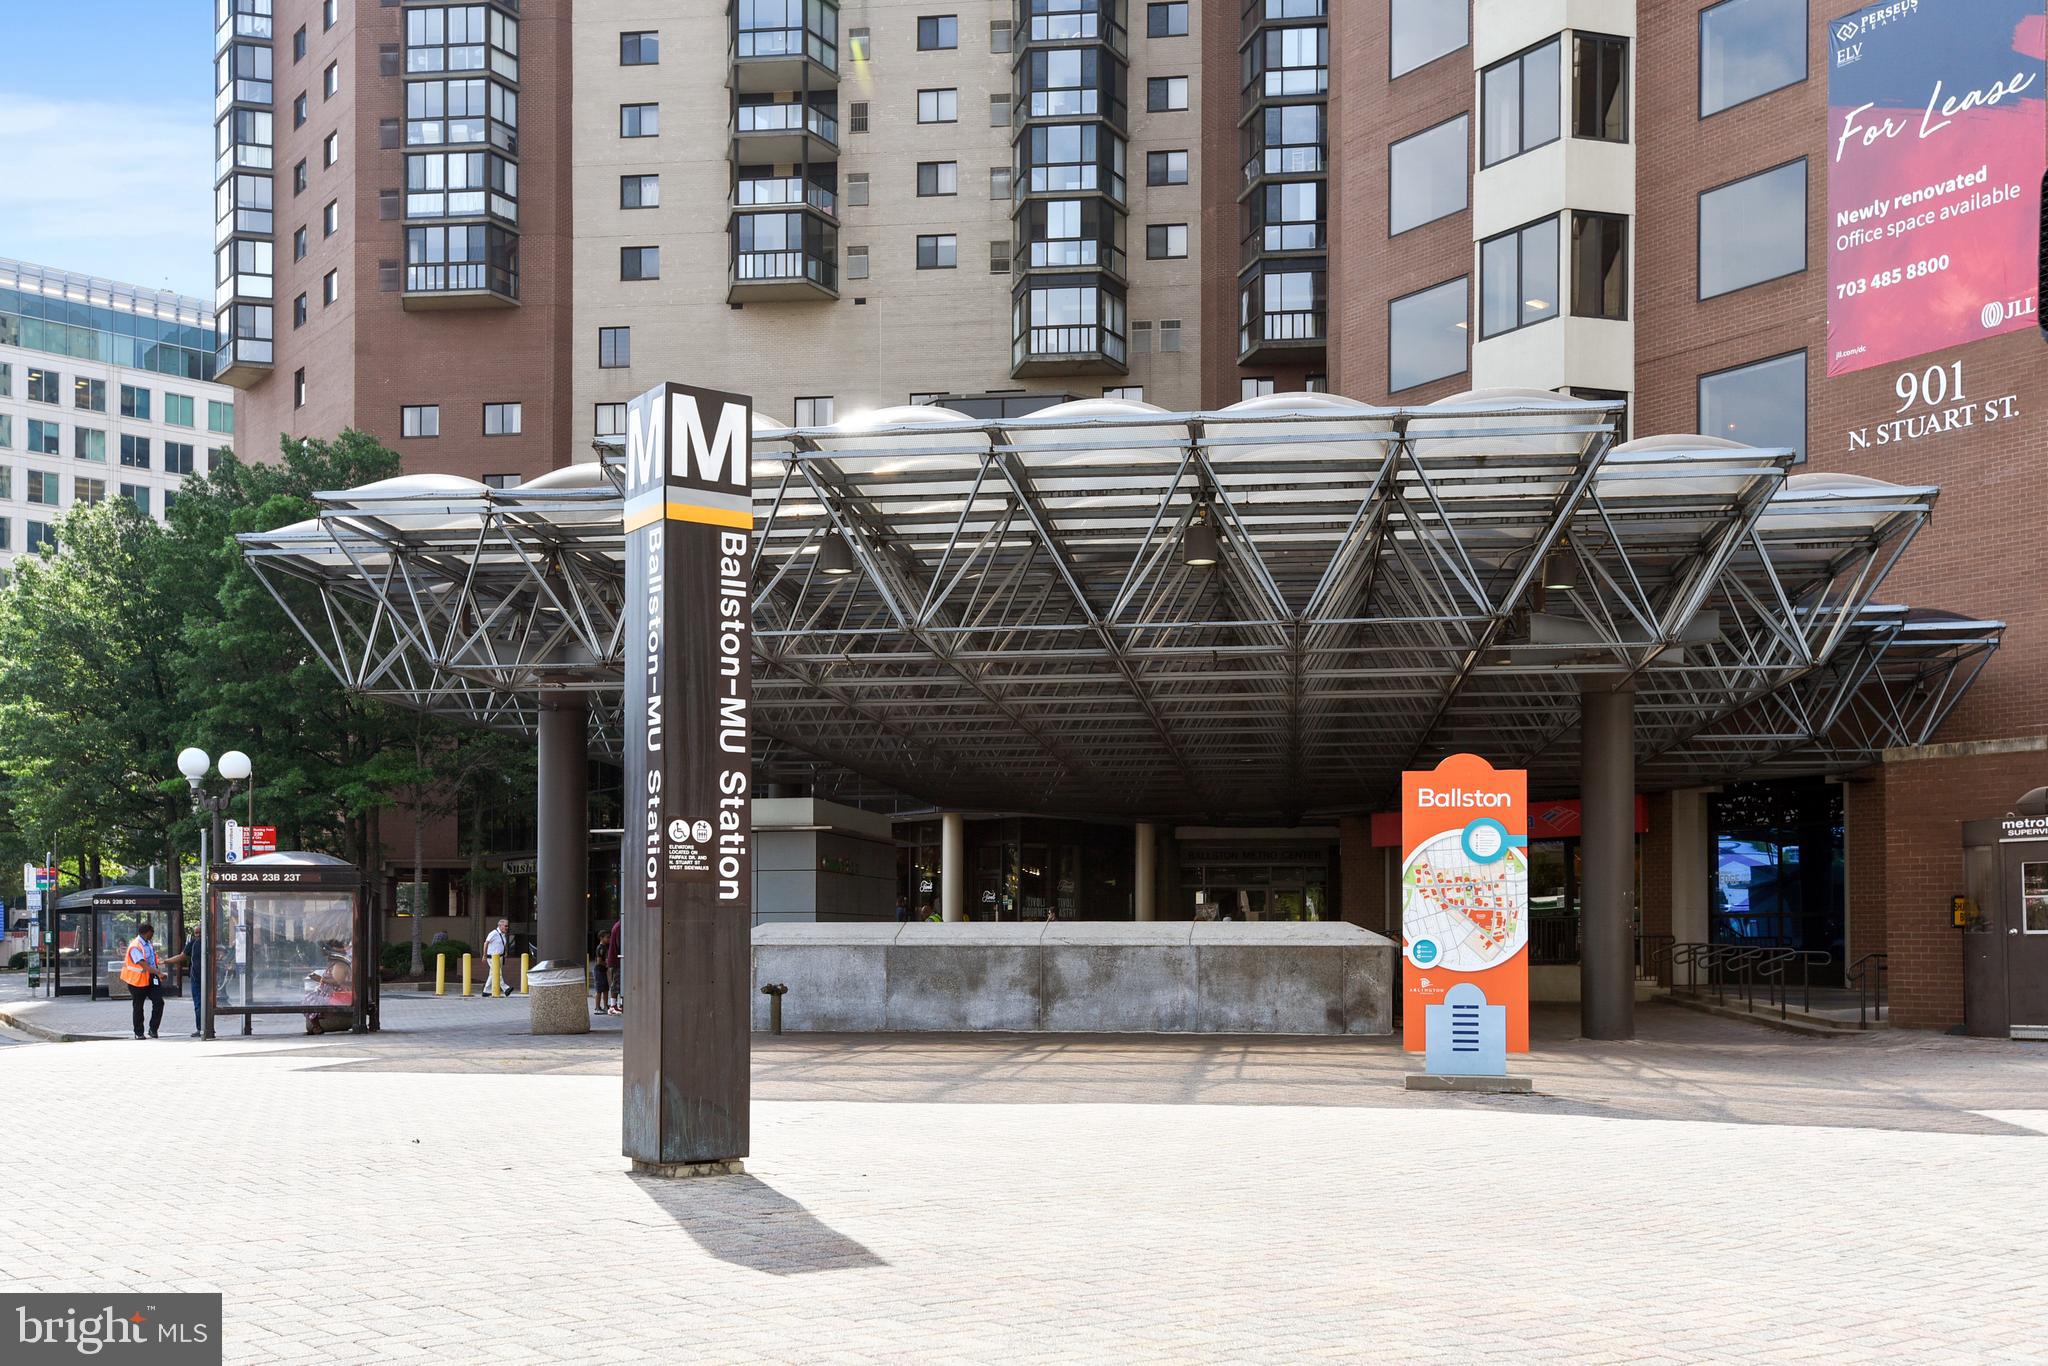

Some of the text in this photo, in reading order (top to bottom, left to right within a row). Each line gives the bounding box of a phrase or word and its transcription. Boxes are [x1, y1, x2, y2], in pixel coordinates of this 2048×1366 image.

[1861, 0, 1919, 28] PERSEUS
[1861, 7, 1918, 34] REALTY
[1837, 42, 1863, 63] ELV
[1836, 73, 2037, 163] For Lease
[1836, 165, 1988, 228] Newly renovated
[1836, 183, 2021, 251] Office space available
[1836, 254, 1950, 300] 703 485 8800
[2004, 297, 2036, 319] JLL
[1835, 344, 1867, 361] jll.com/dc
[1895, 360, 1966, 414] 901
[628, 394, 664, 492] M
[671, 391, 747, 487] M
[1848, 395, 2020, 451] N. STUART ST.
[1418, 788, 1511, 807] Ballston
[647, 769, 662, 901] Station
[718, 770, 747, 901] Station
[221, 873, 301, 881] 10B 23A 23B 23T
